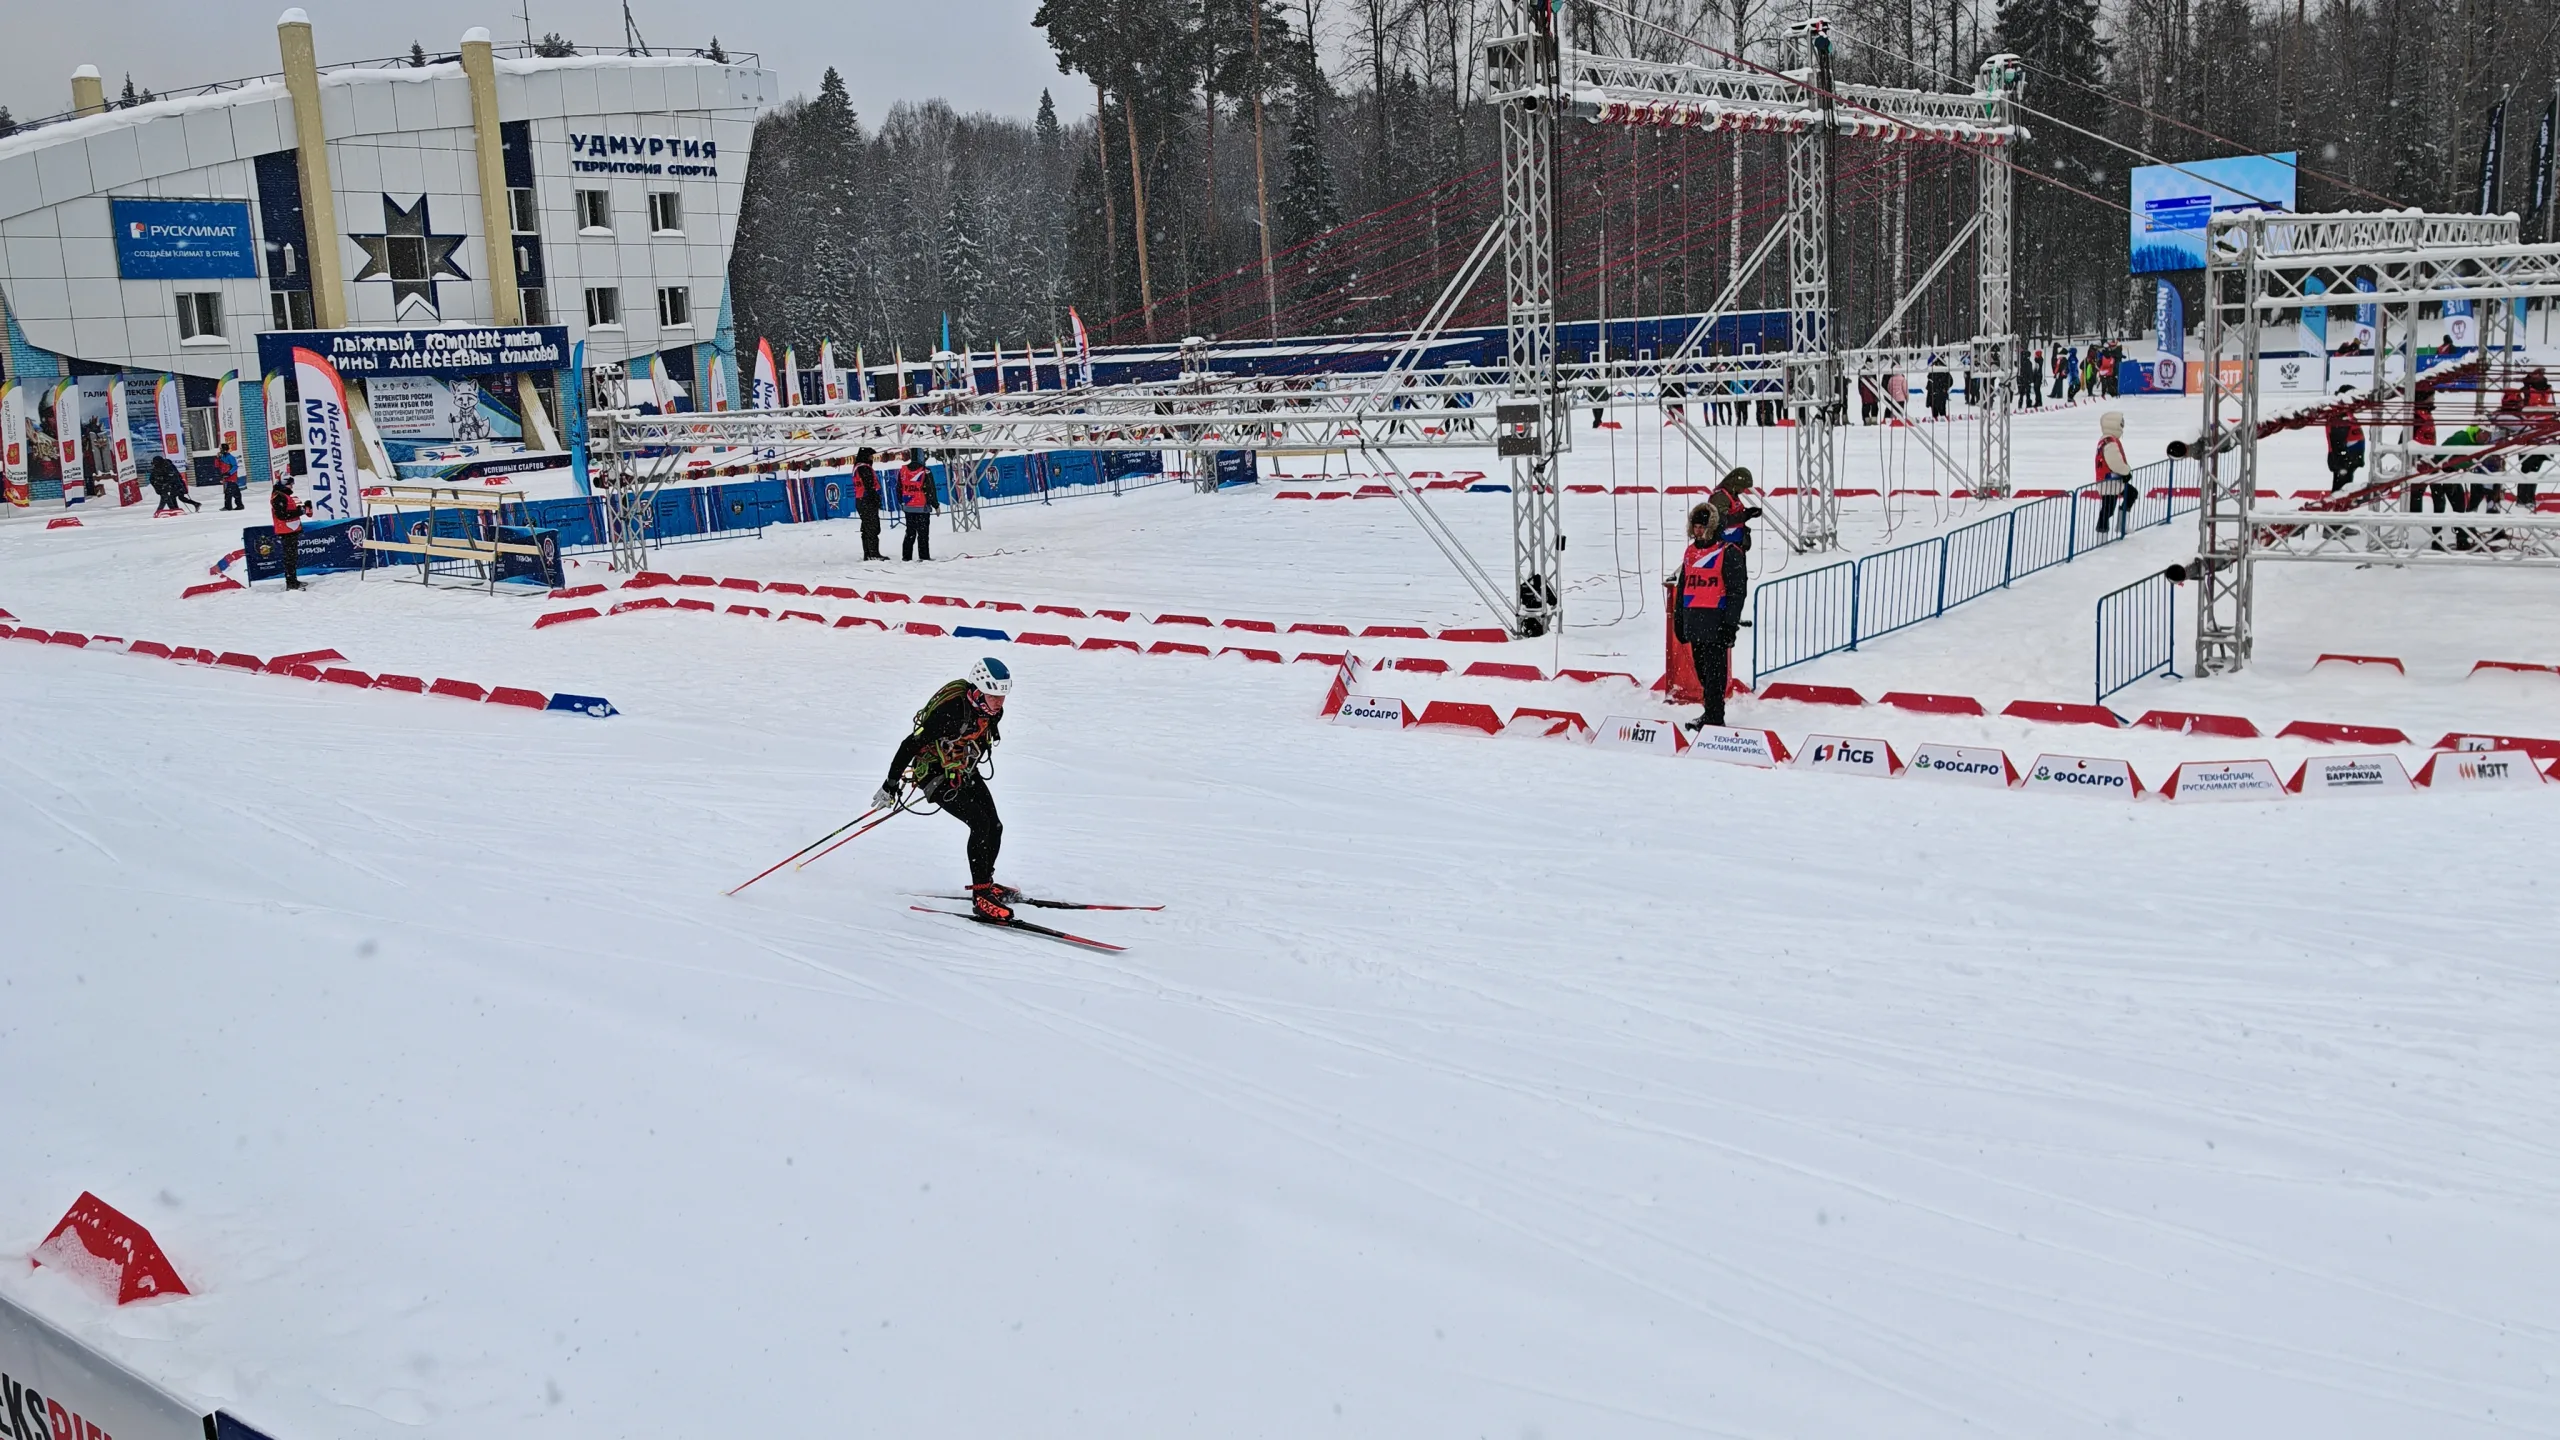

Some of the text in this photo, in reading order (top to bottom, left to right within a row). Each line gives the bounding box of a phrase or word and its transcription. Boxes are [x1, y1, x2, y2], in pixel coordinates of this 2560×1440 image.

[570, 133, 717, 159] УДМУРТИЯ
[572, 160, 718, 177] ТЕРРИТОРИЯ СПОРТА
[150, 225, 237, 238] РУСКЛИМАТ
[134, 249, 172, 258] СОЗДАЁМ
[173, 250, 204, 258] КЛИМАТ
[212, 250, 240, 258] СТРАНЕ
[333, 330, 543, 352] ЛЫЖНЫЙ КОМПЛЕКС ИМЕНИ
[326, 344, 559, 370] ЛИНЫ АЛЕКСЕЕВНЫ КУЛАКОВОЙ
[2220, 369, 2241, 385] ЗТТ
[125, 388, 155, 396] ЛЕКСЕЕ
[400, 401, 419, 409] КУБОК
[483, 464, 517, 475] УСПЕШНЫХ
[297, 537, 336, 547] ОРТИВНЫЙ
[1686, 575, 1718, 588] ДЬЯ
[1354, 708, 1398, 719] ФОСАГРО
[1713, 735, 1759, 746] ТЕХНОПАРК
[1697, 742, 1742, 753] РУСКЛИМАТ
[1837, 748, 1874, 764] ПСБ
[1933, 759, 1999, 775] ФОСАГРО
[2053, 771, 2124, 787] ФОСАГРО
[2197, 772, 2254, 782] ТЕХНОПАРК
[2326, 770, 2383, 781] БАРРАКУДА
[2182, 782, 2237, 792] РУСКЛИМАТ
